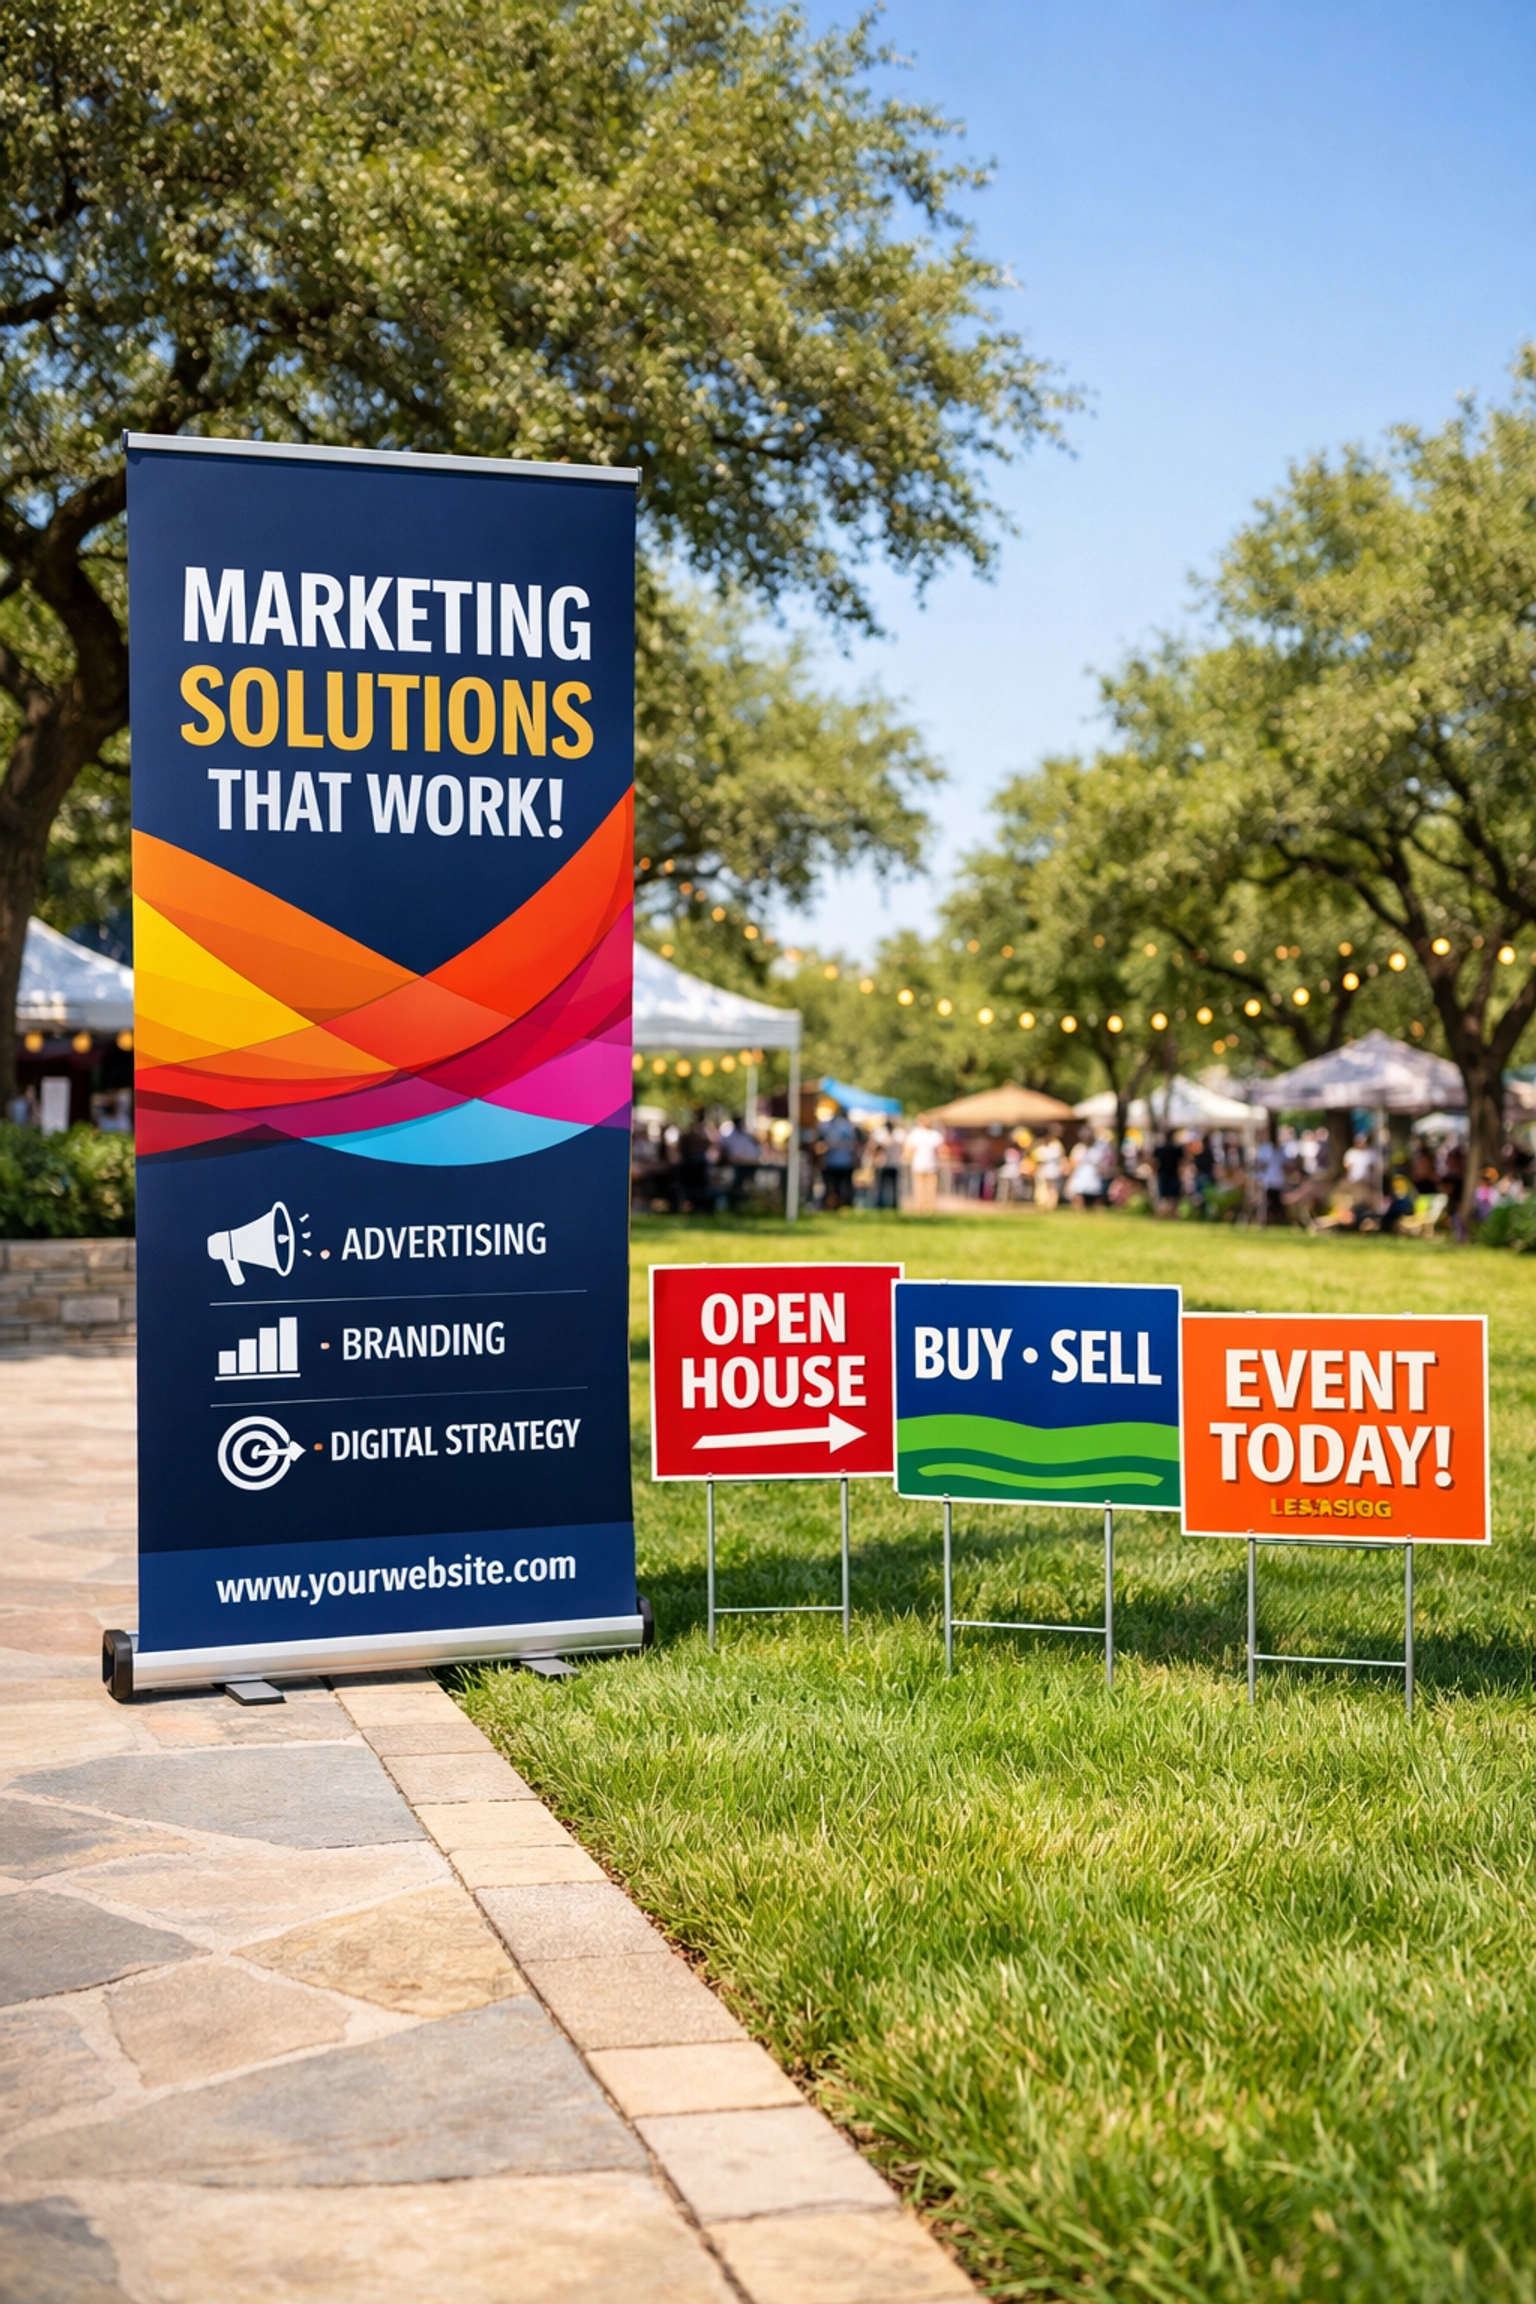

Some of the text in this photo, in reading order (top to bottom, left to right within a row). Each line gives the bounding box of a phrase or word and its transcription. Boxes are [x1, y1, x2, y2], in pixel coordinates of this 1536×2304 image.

[183, 566, 591, 661] MARKETING
[180, 664, 594, 759] SOLUTIONS
[207, 768, 563, 839] THAT WORK!
[341, 1222, 546, 1261] ADVERTISING
[343, 1321, 505, 1361] BRANDING
[700, 1292, 846, 1346] OPEN
[681, 1355, 867, 1409] HOUSE
[914, 1326, 1013, 1381] BUY
[1050, 1329, 1162, 1385] SELL
[1225, 1348, 1436, 1411] EVENT
[331, 1418, 581, 1461] DIGITAL STRATEGY
[1209, 1422, 1452, 1487] TODAY!
[215, 1553, 576, 1606] www.yourwebsite.com
